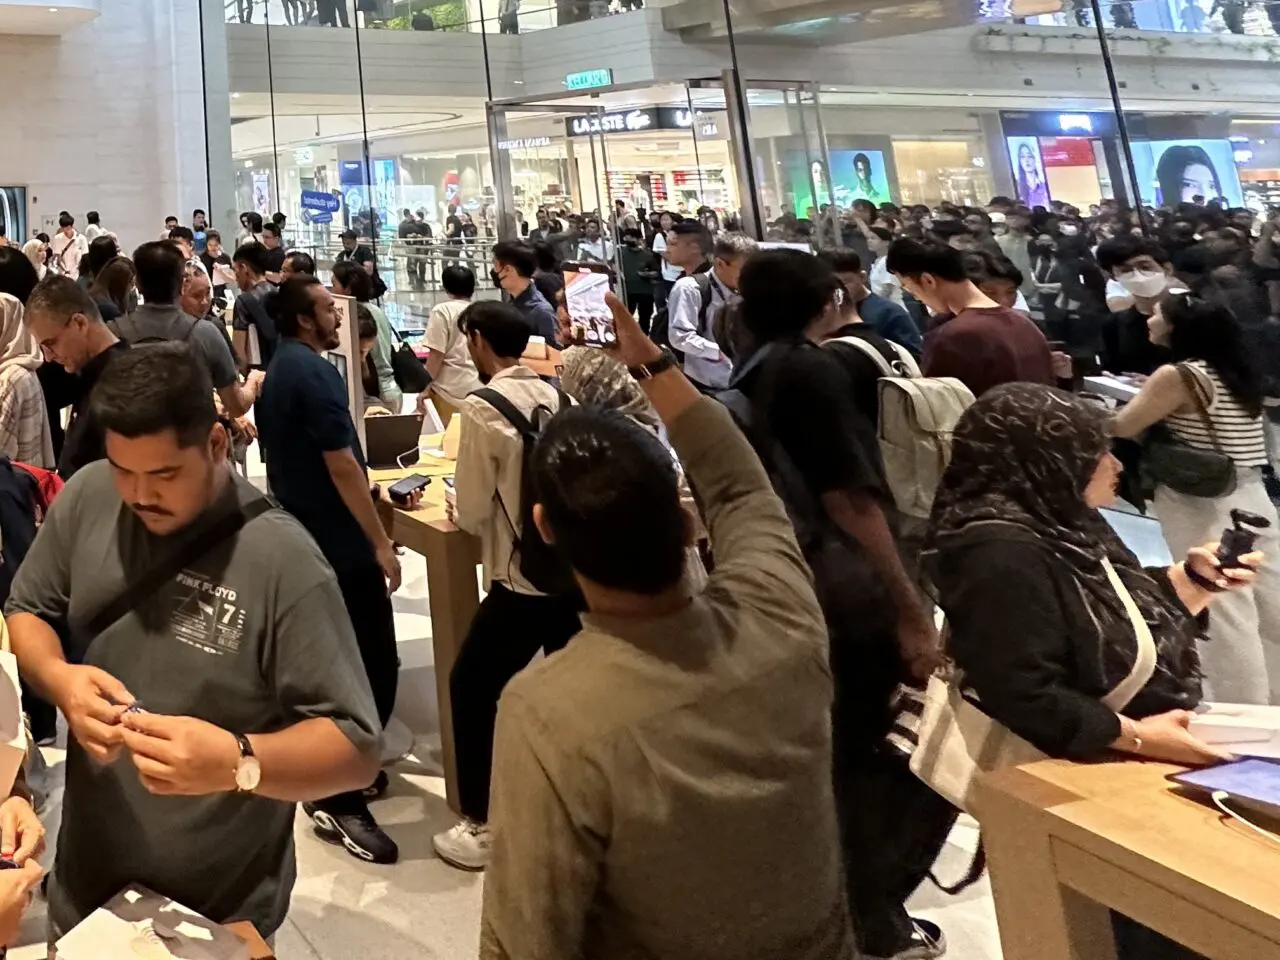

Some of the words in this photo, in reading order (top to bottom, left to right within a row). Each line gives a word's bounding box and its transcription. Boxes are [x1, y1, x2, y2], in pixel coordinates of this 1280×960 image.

[573, 114, 625, 134] LASTE
[176, 573, 201, 589] PINK
[202, 582, 237, 601] FLOYD
[222, 603, 236, 624] 7
